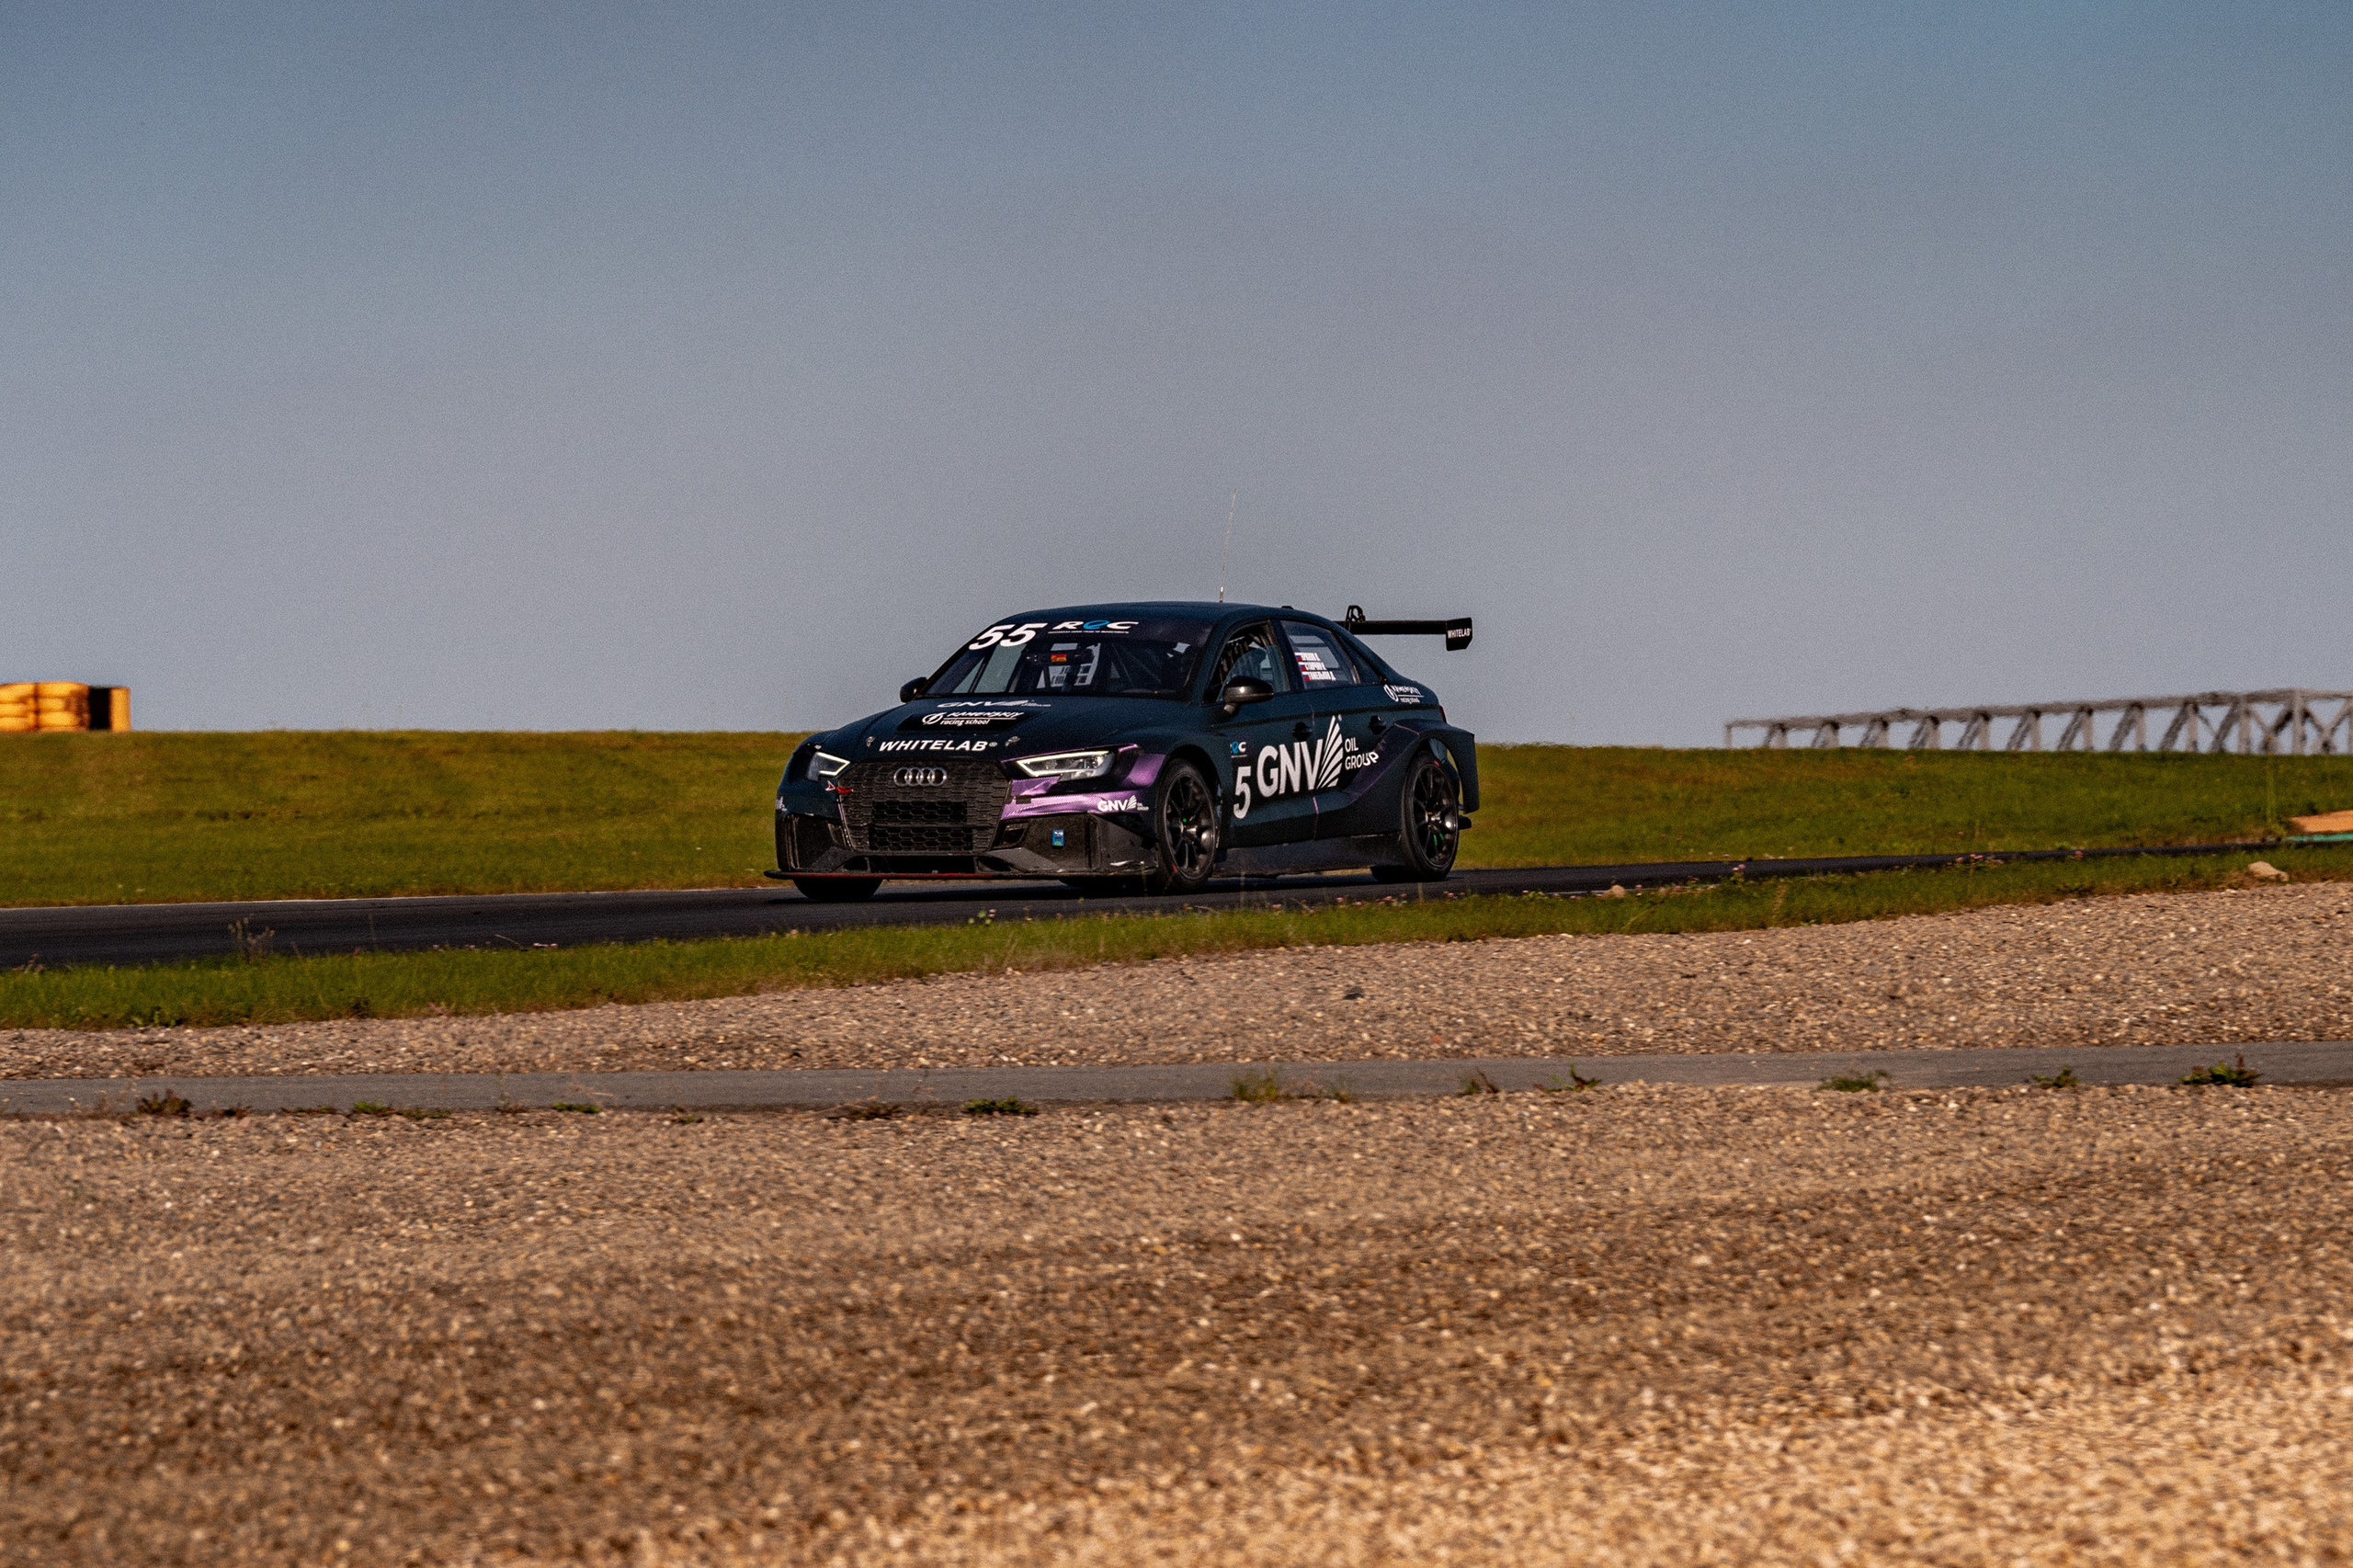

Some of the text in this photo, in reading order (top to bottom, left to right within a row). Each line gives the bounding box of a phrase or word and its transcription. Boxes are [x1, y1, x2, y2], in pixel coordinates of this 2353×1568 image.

[968, 622, 1048, 651] 55
[1447, 628, 1471, 639] WHITELAB
[879, 740, 990, 752] WHITELAB
[1344, 737, 1359, 752] OIL
[1256, 738, 1324, 798] GNV
[1345, 751, 1380, 770] GROUP
[1233, 766, 1252, 820] 5
[1097, 800, 1128, 812] GNV
